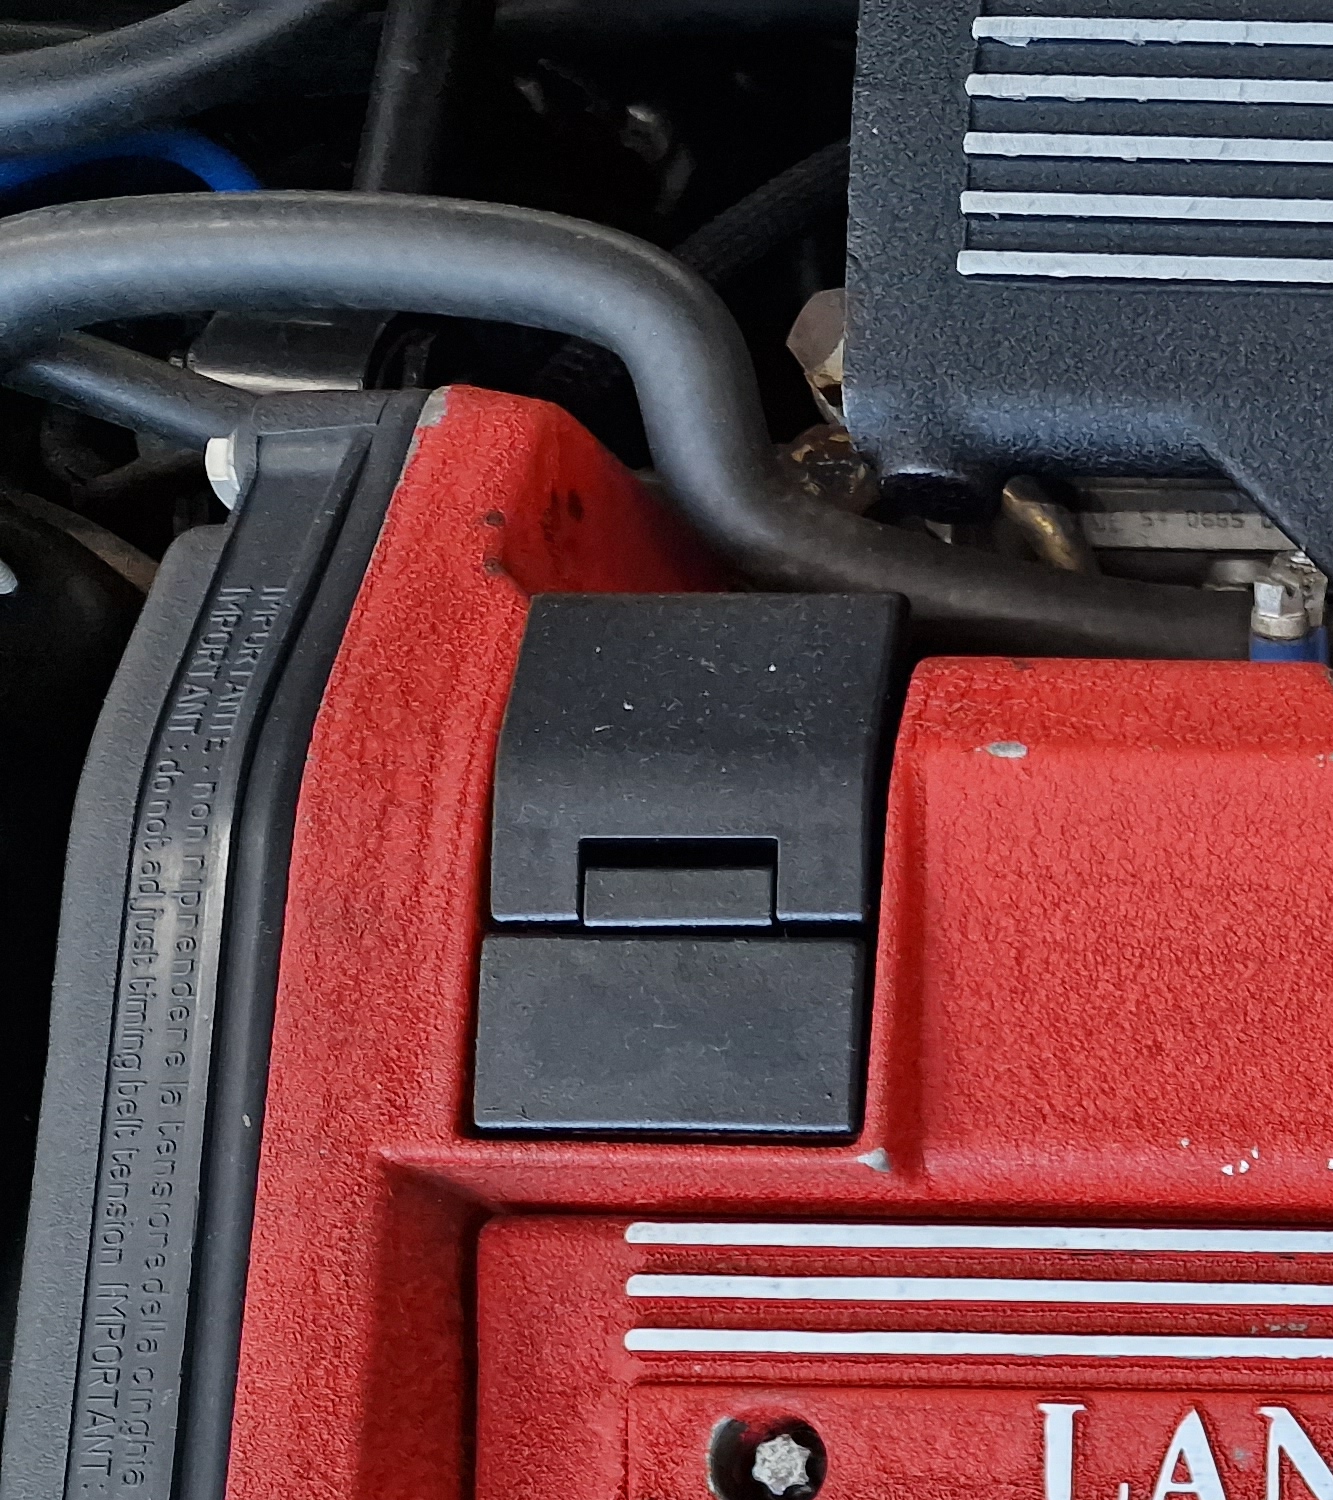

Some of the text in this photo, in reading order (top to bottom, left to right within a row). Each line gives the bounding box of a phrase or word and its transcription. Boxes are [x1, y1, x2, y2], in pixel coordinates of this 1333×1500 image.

[152, 759, 184, 794] do
[184, 782, 216, 844] non
[143, 800, 172, 853] not
[128, 859, 166, 968] adjust
[112, 976, 157, 1072] timing
[113, 1079, 148, 1140] belt
[159, 1080, 189, 1107] la
[101, 1147, 140, 1267] tension
[145, 1121, 185, 1270] tensione
[136, 1277, 170, 1355] della
[119, 1366, 156, 1488] cinghia
